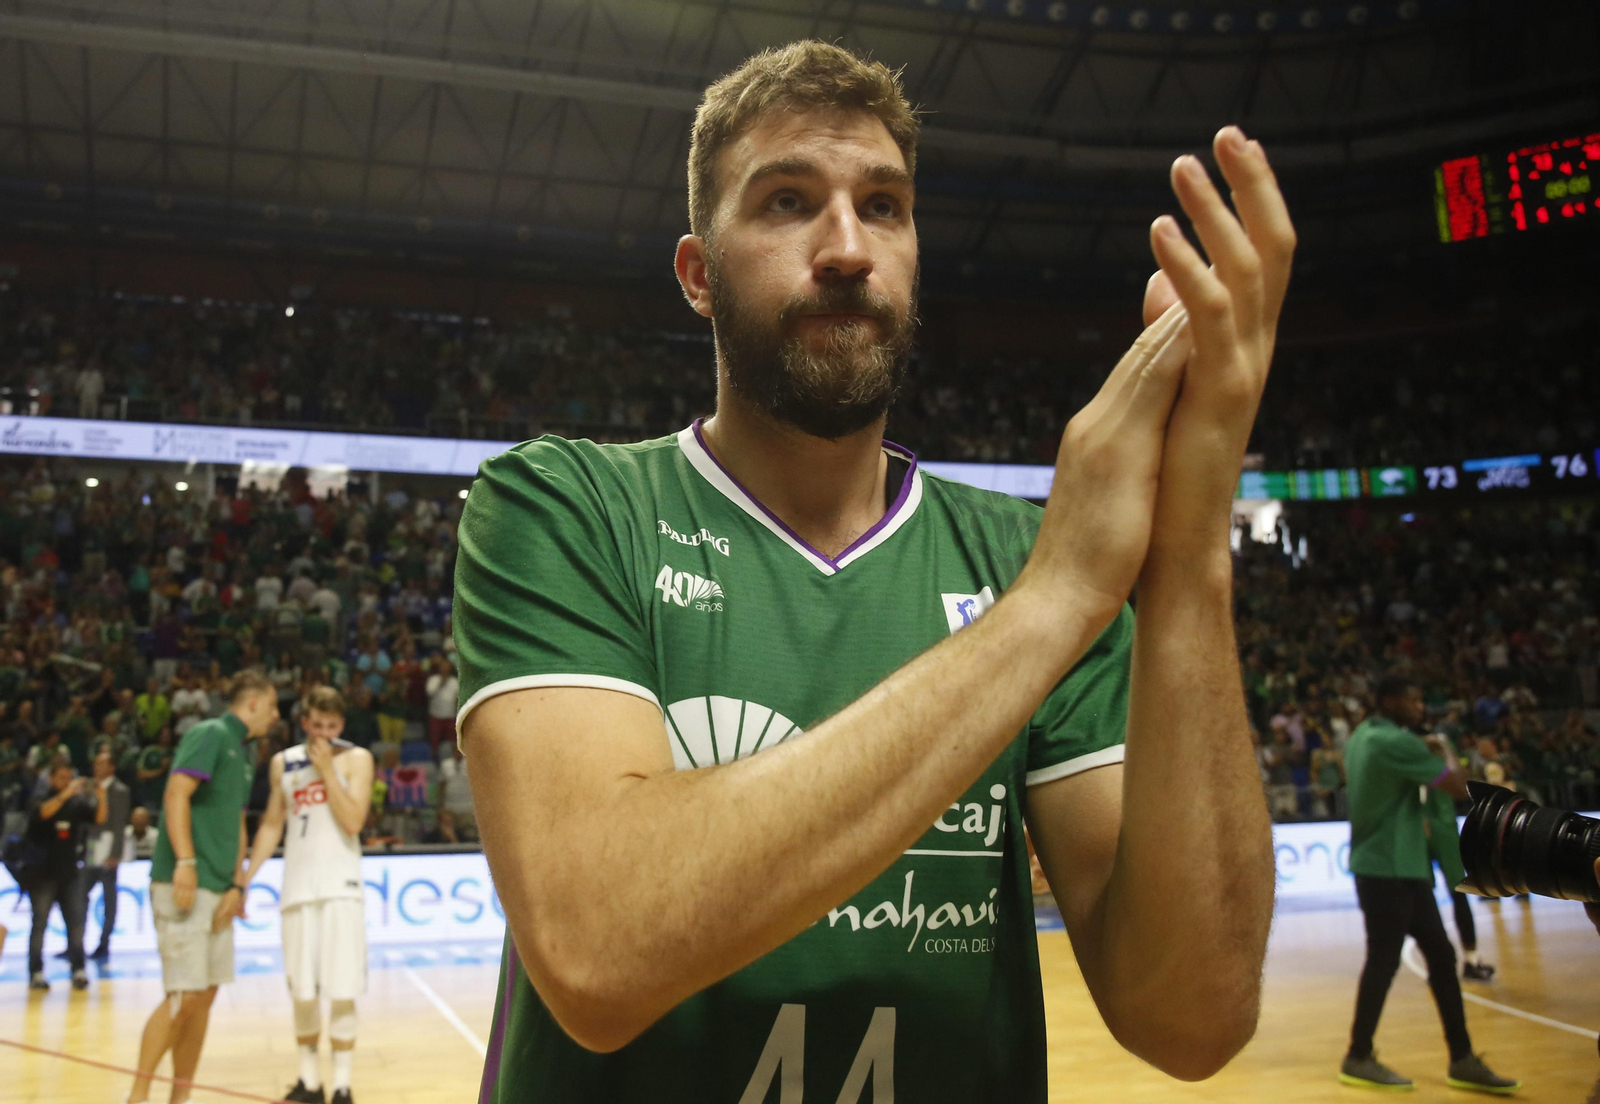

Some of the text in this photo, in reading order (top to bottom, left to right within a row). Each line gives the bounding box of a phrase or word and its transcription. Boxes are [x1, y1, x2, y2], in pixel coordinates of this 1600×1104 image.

[1423, 465, 1458, 490] 73
[1550, 453, 1588, 479] 76
[695, 601, 724, 613] años
[300, 813, 310, 838] 7
[933, 783, 1006, 848] caj
[826, 869, 1000, 953] nahaví
[924, 938, 968, 954] COSTA
